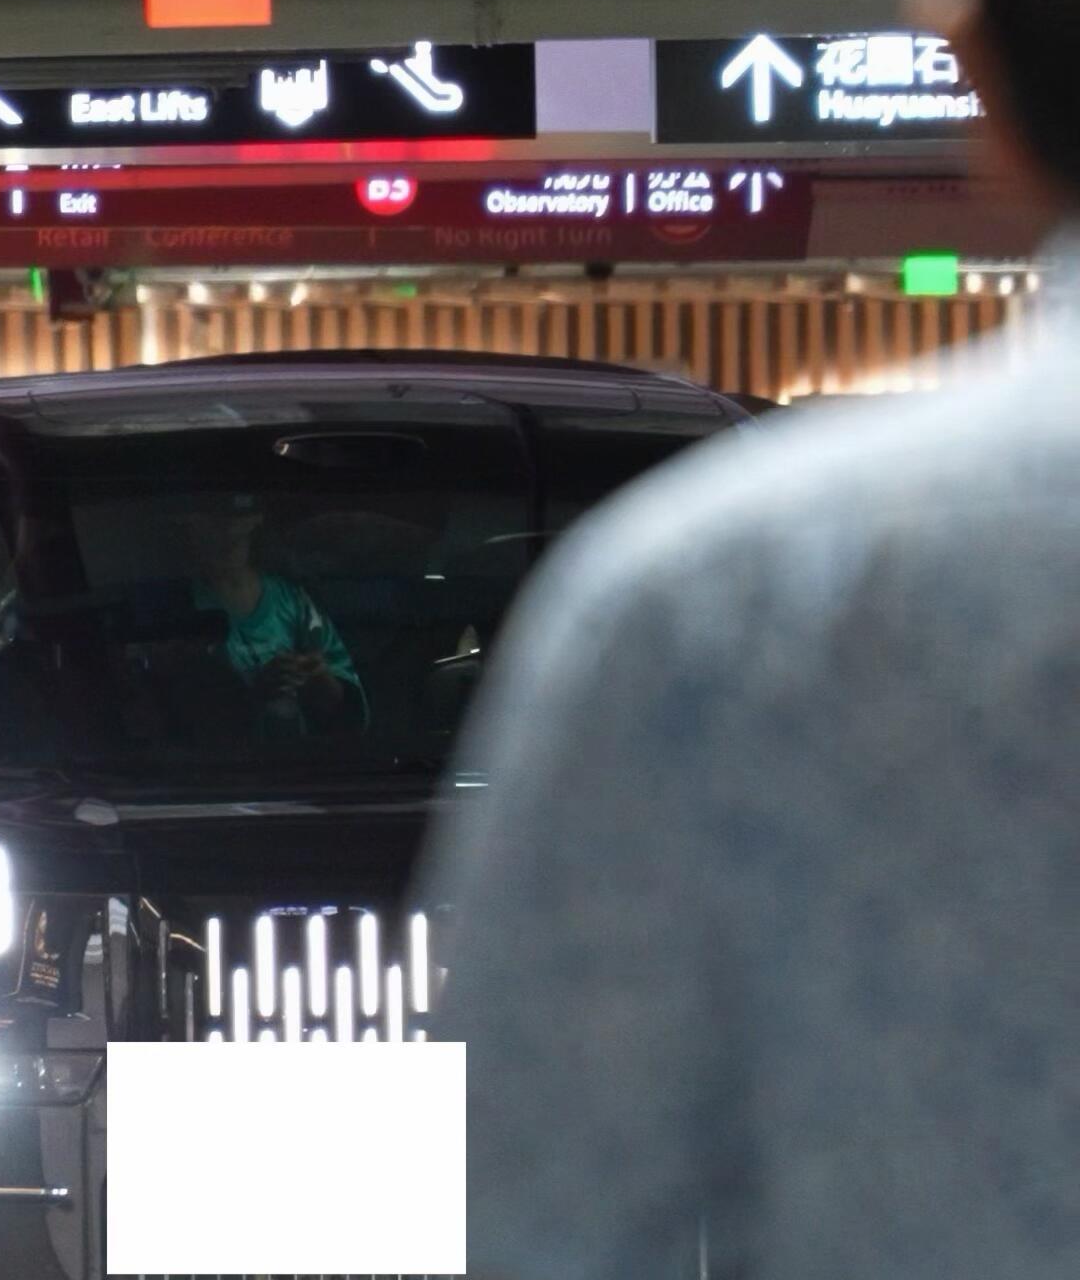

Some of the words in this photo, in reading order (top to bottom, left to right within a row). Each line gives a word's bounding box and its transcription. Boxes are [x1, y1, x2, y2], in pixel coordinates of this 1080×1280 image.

[817, 36, 957, 84] 花石
[71, 94, 135, 123] East
[140, 91, 208, 123] Lifts
[60, 192, 97, 214] Exit
[486, 189, 610, 218] Observatory
[647, 189, 714, 213] Office
[434, 226, 471, 247] No
